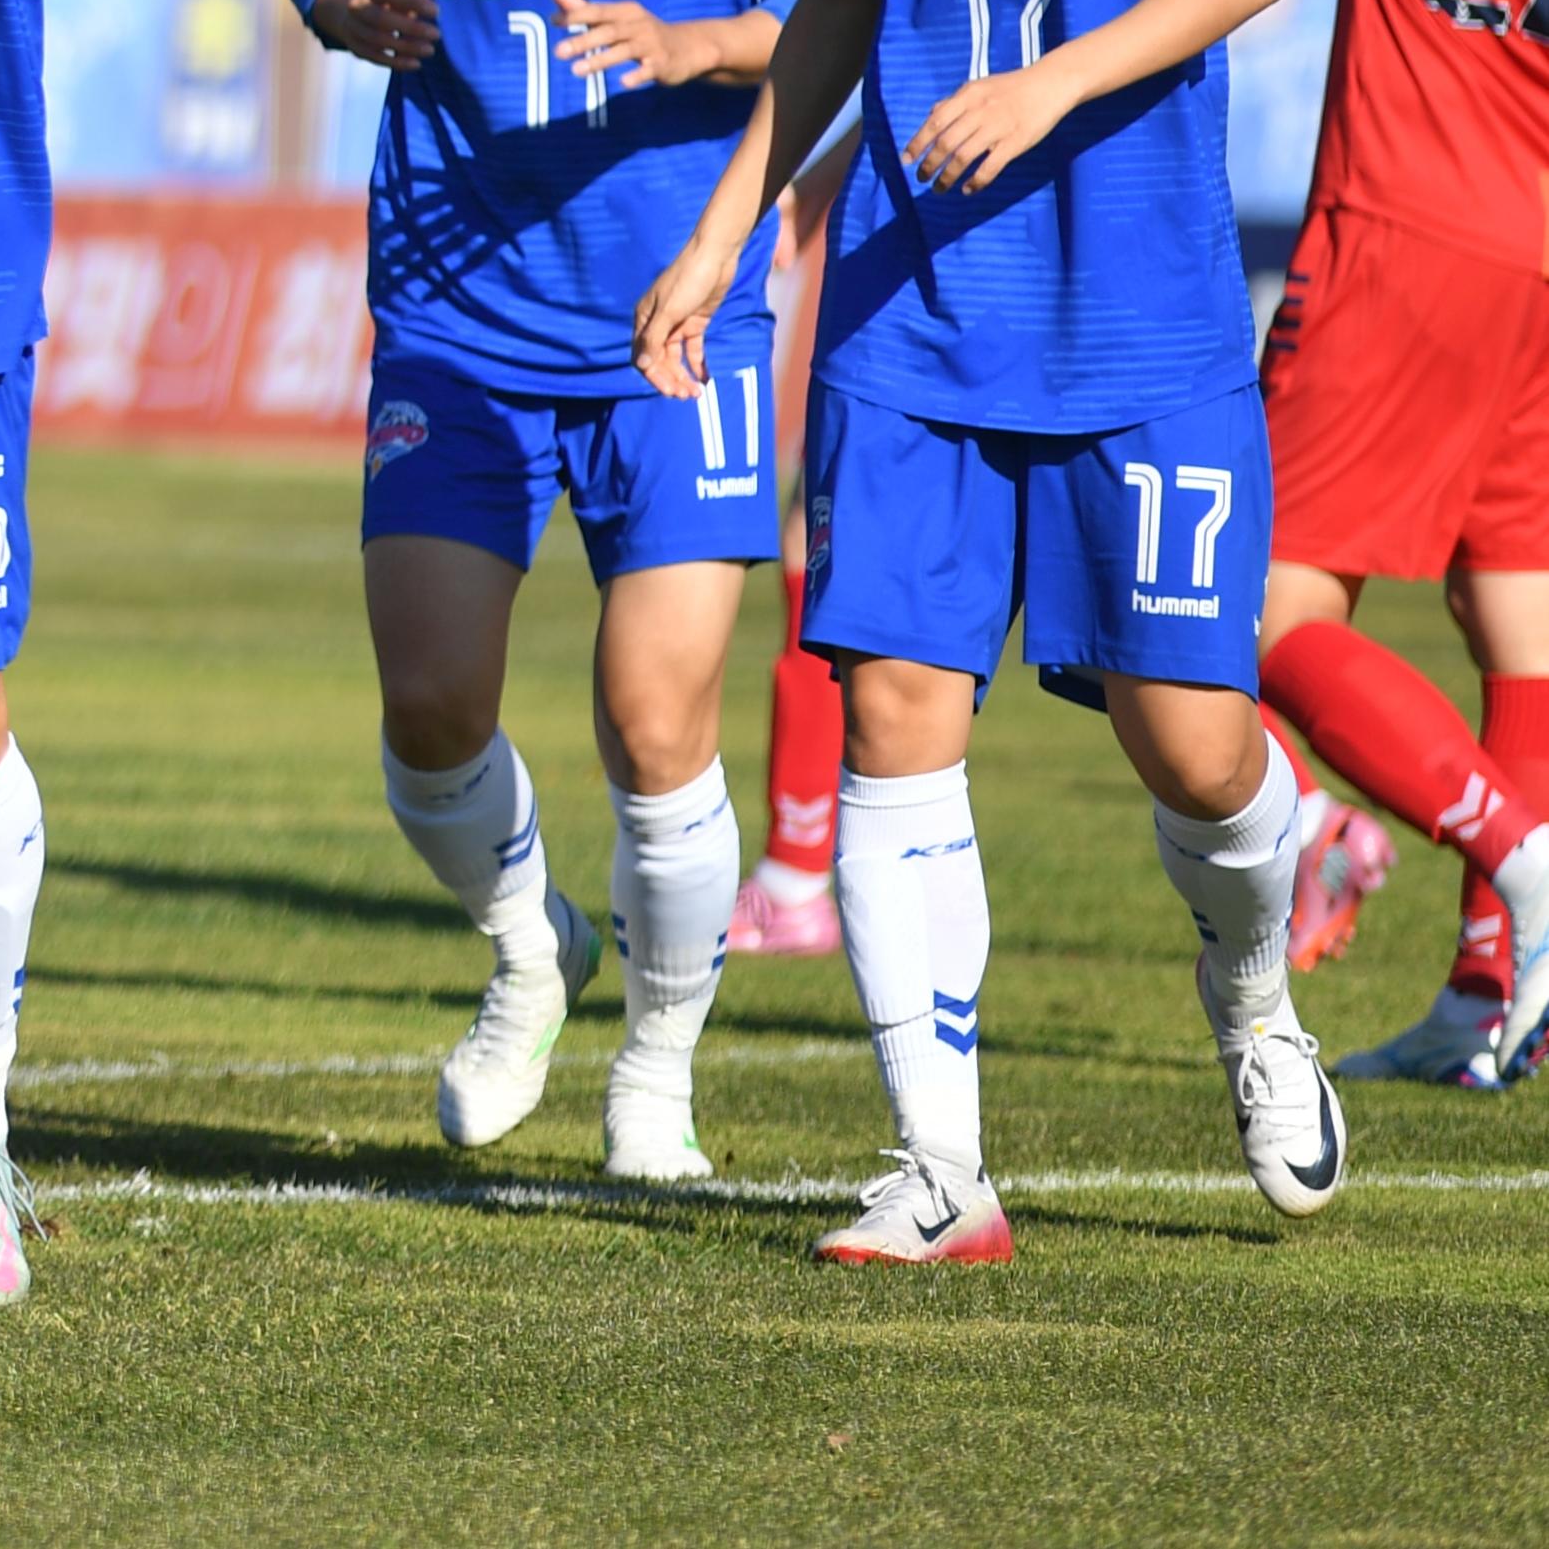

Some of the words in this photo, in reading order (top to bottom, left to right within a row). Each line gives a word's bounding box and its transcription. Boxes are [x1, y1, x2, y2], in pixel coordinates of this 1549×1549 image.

[696, 364, 759, 471] 11
[1124, 462, 1232, 588] 17
[1132, 589, 1219, 619] hummel
